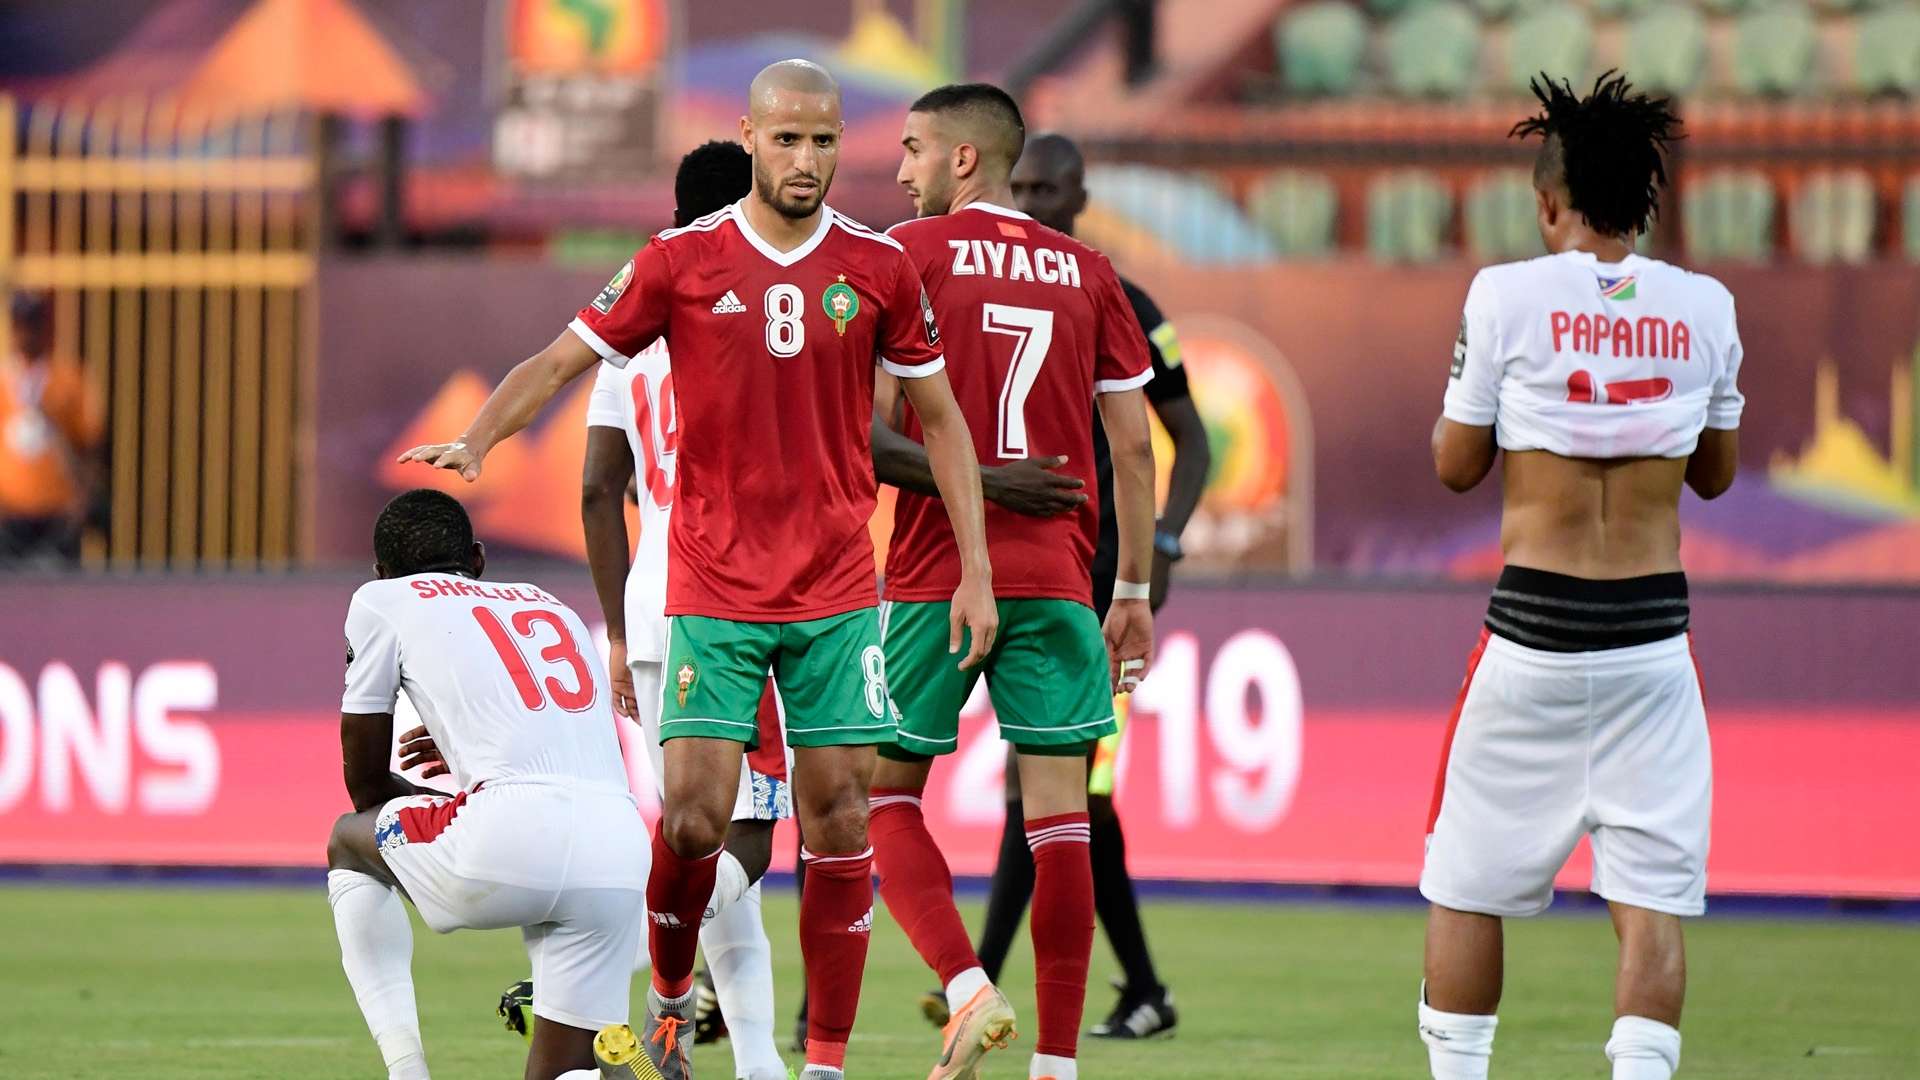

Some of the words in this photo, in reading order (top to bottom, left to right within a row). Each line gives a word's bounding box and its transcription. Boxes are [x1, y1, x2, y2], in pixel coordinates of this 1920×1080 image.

[948, 239, 1081, 288] ZIYACH
[764, 283, 805, 358] 8
[1551, 311, 1690, 361] PAPAMA
[982, 302, 1054, 459] 7
[472, 606, 597, 713] 13
[861, 645, 886, 719] 8
